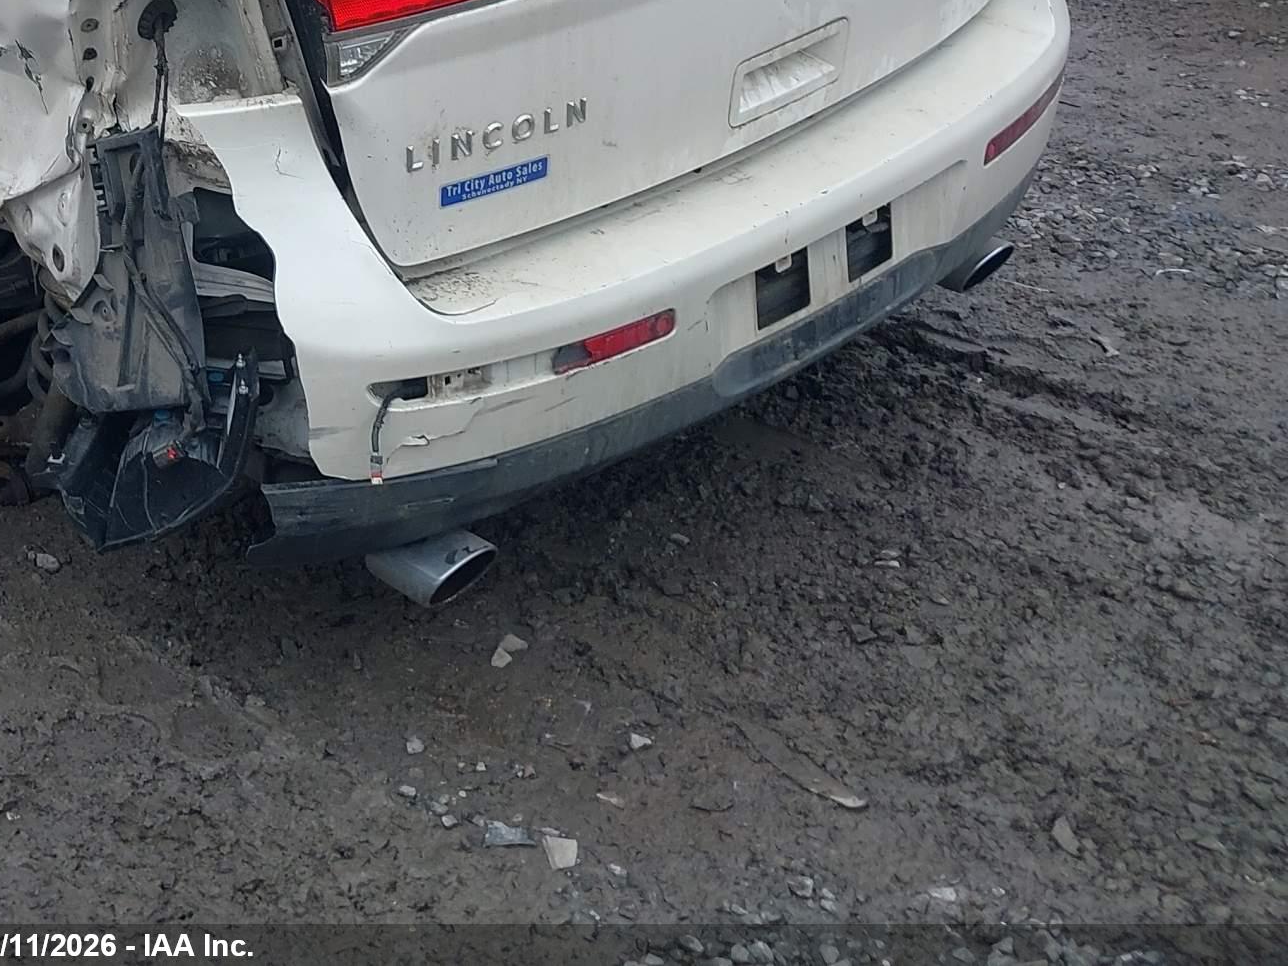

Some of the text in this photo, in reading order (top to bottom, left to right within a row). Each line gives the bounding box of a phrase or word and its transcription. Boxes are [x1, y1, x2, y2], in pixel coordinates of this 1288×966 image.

[406, 97, 587, 173] LINCOLN
[446, 161, 543, 197] Tri City Auto Sales
[461, 175, 528, 201] Schenectady NY
